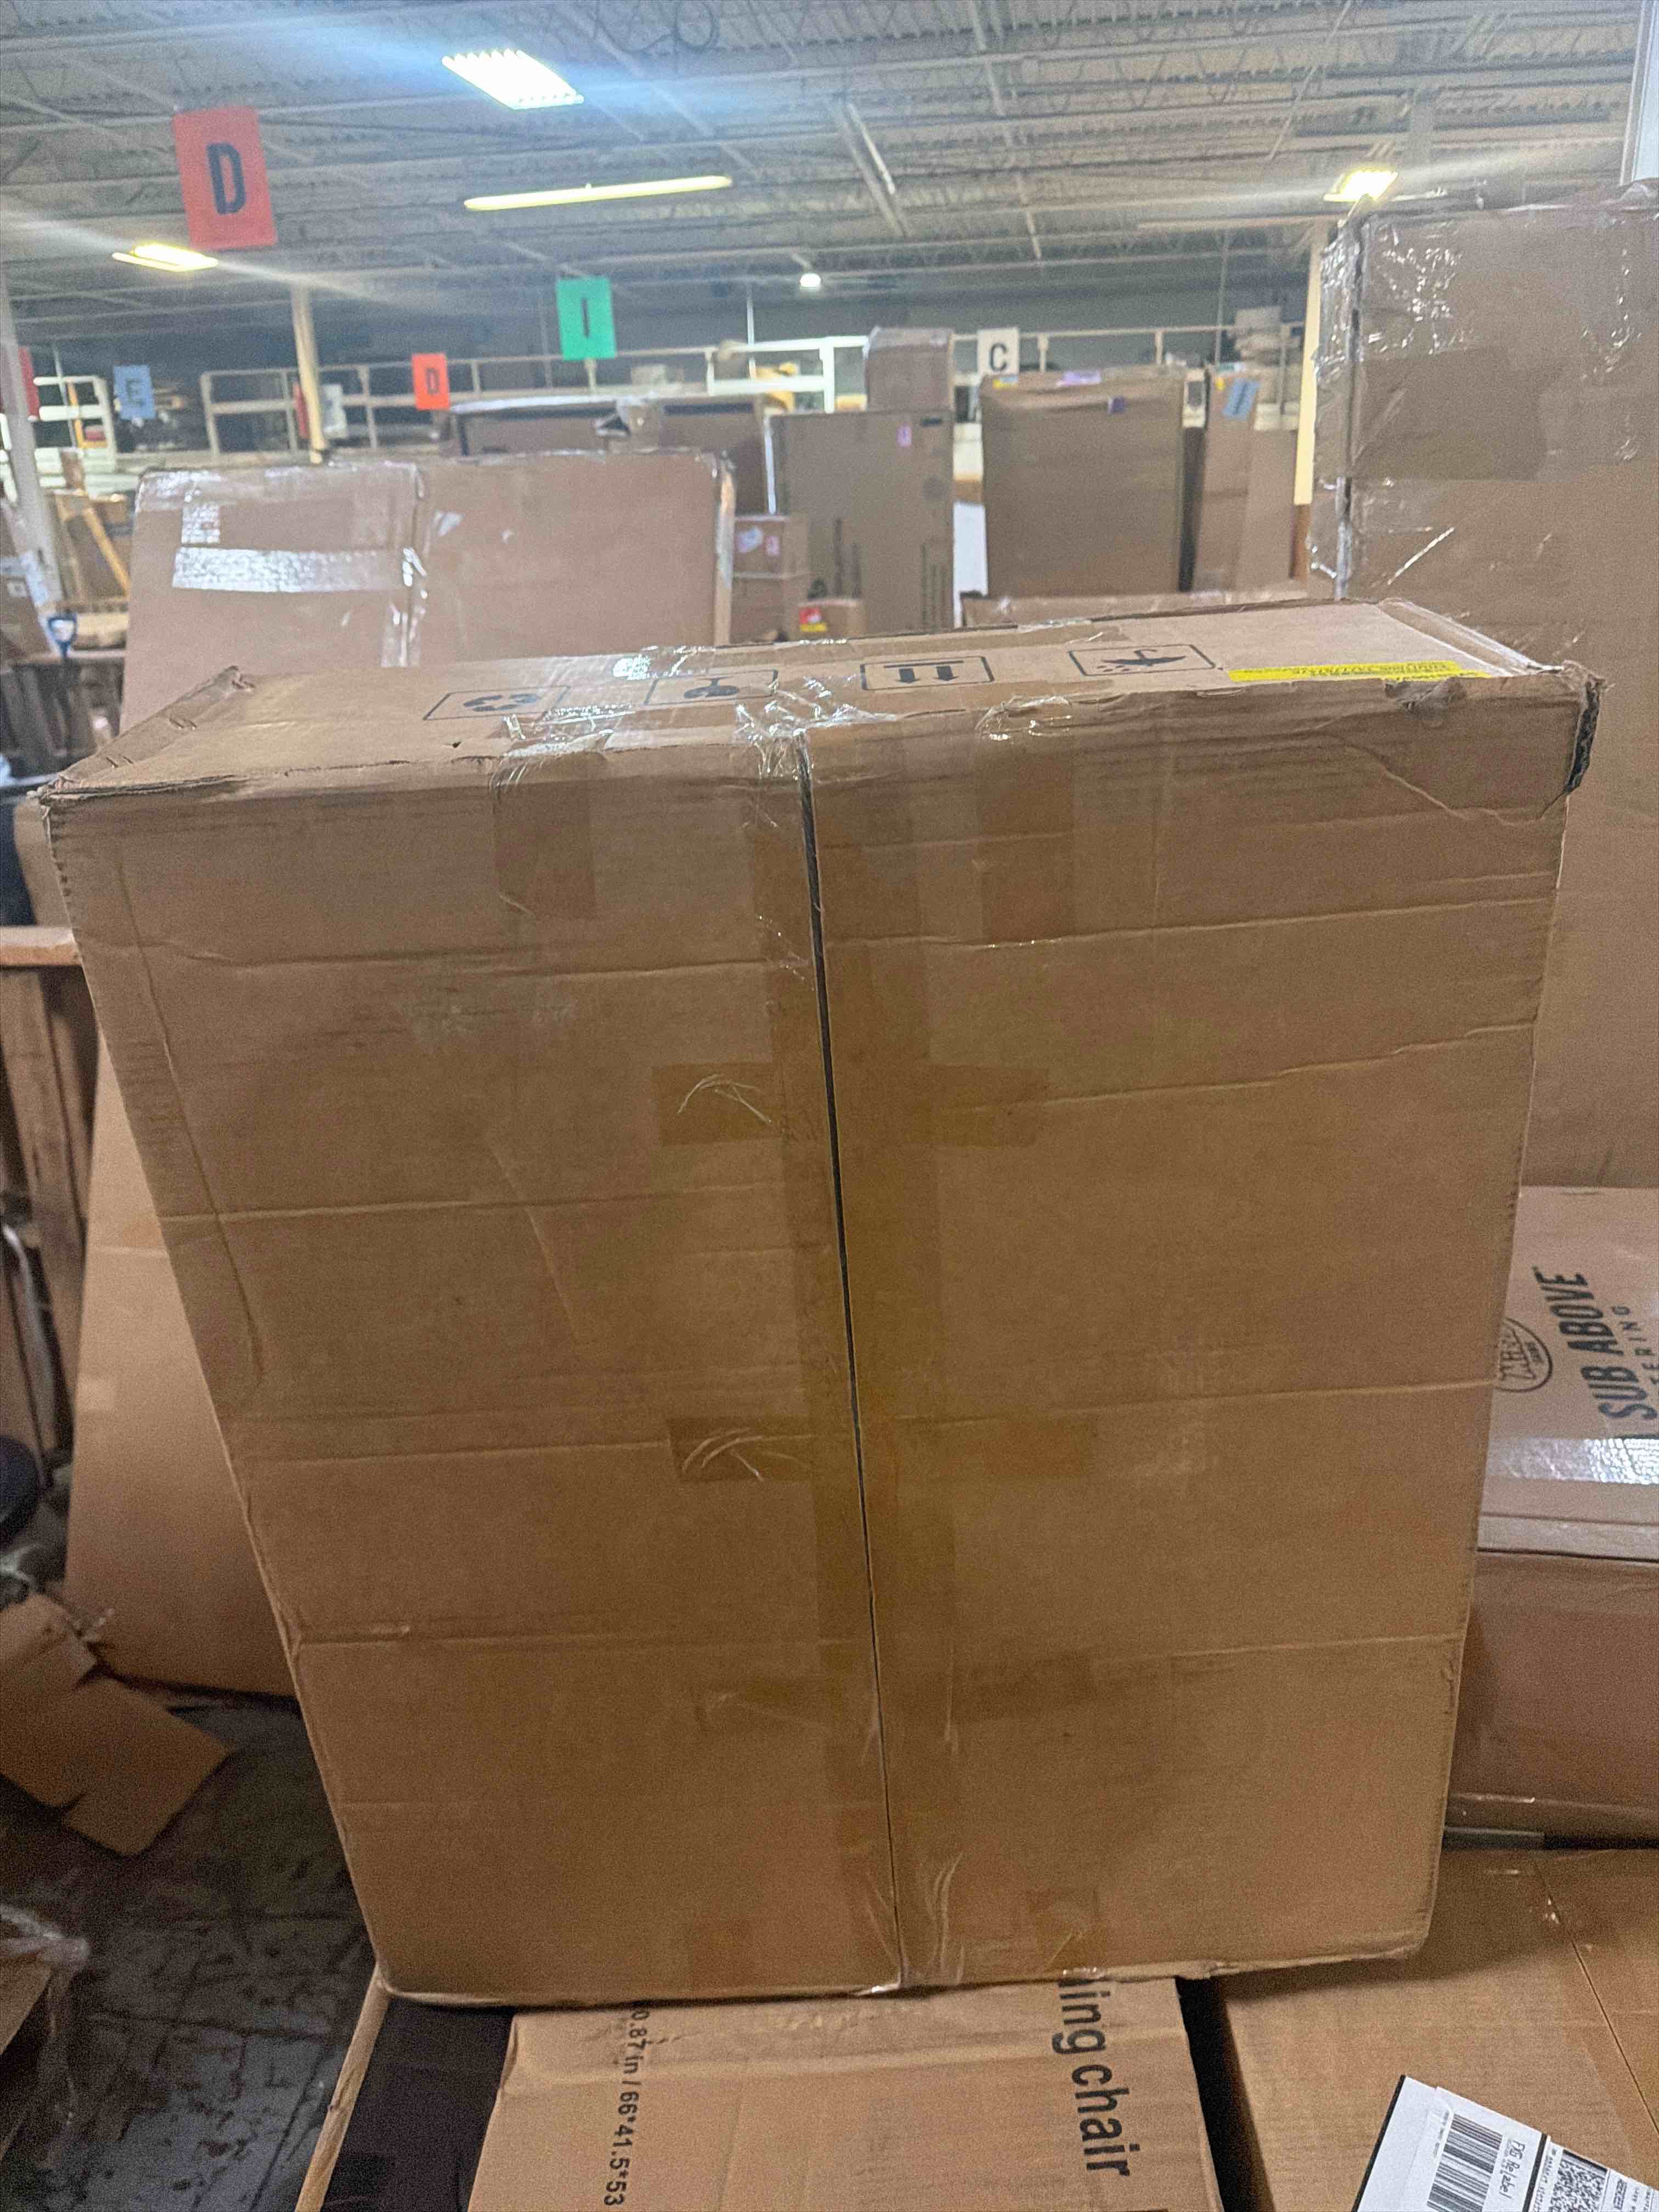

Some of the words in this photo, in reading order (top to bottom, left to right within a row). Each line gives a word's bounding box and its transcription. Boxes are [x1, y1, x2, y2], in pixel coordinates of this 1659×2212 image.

[206, 143, 246, 215] D
[990, 343, 1007, 372] C
[1532, 1266, 1624, 1356] ABOVE
[1581, 1365, 1658, 1420] SUB
[623, 2055, 645, 2074] in
[1072, 2063, 1141, 2177] chair
[1498, 2159, 1520, 2199] Relabel
